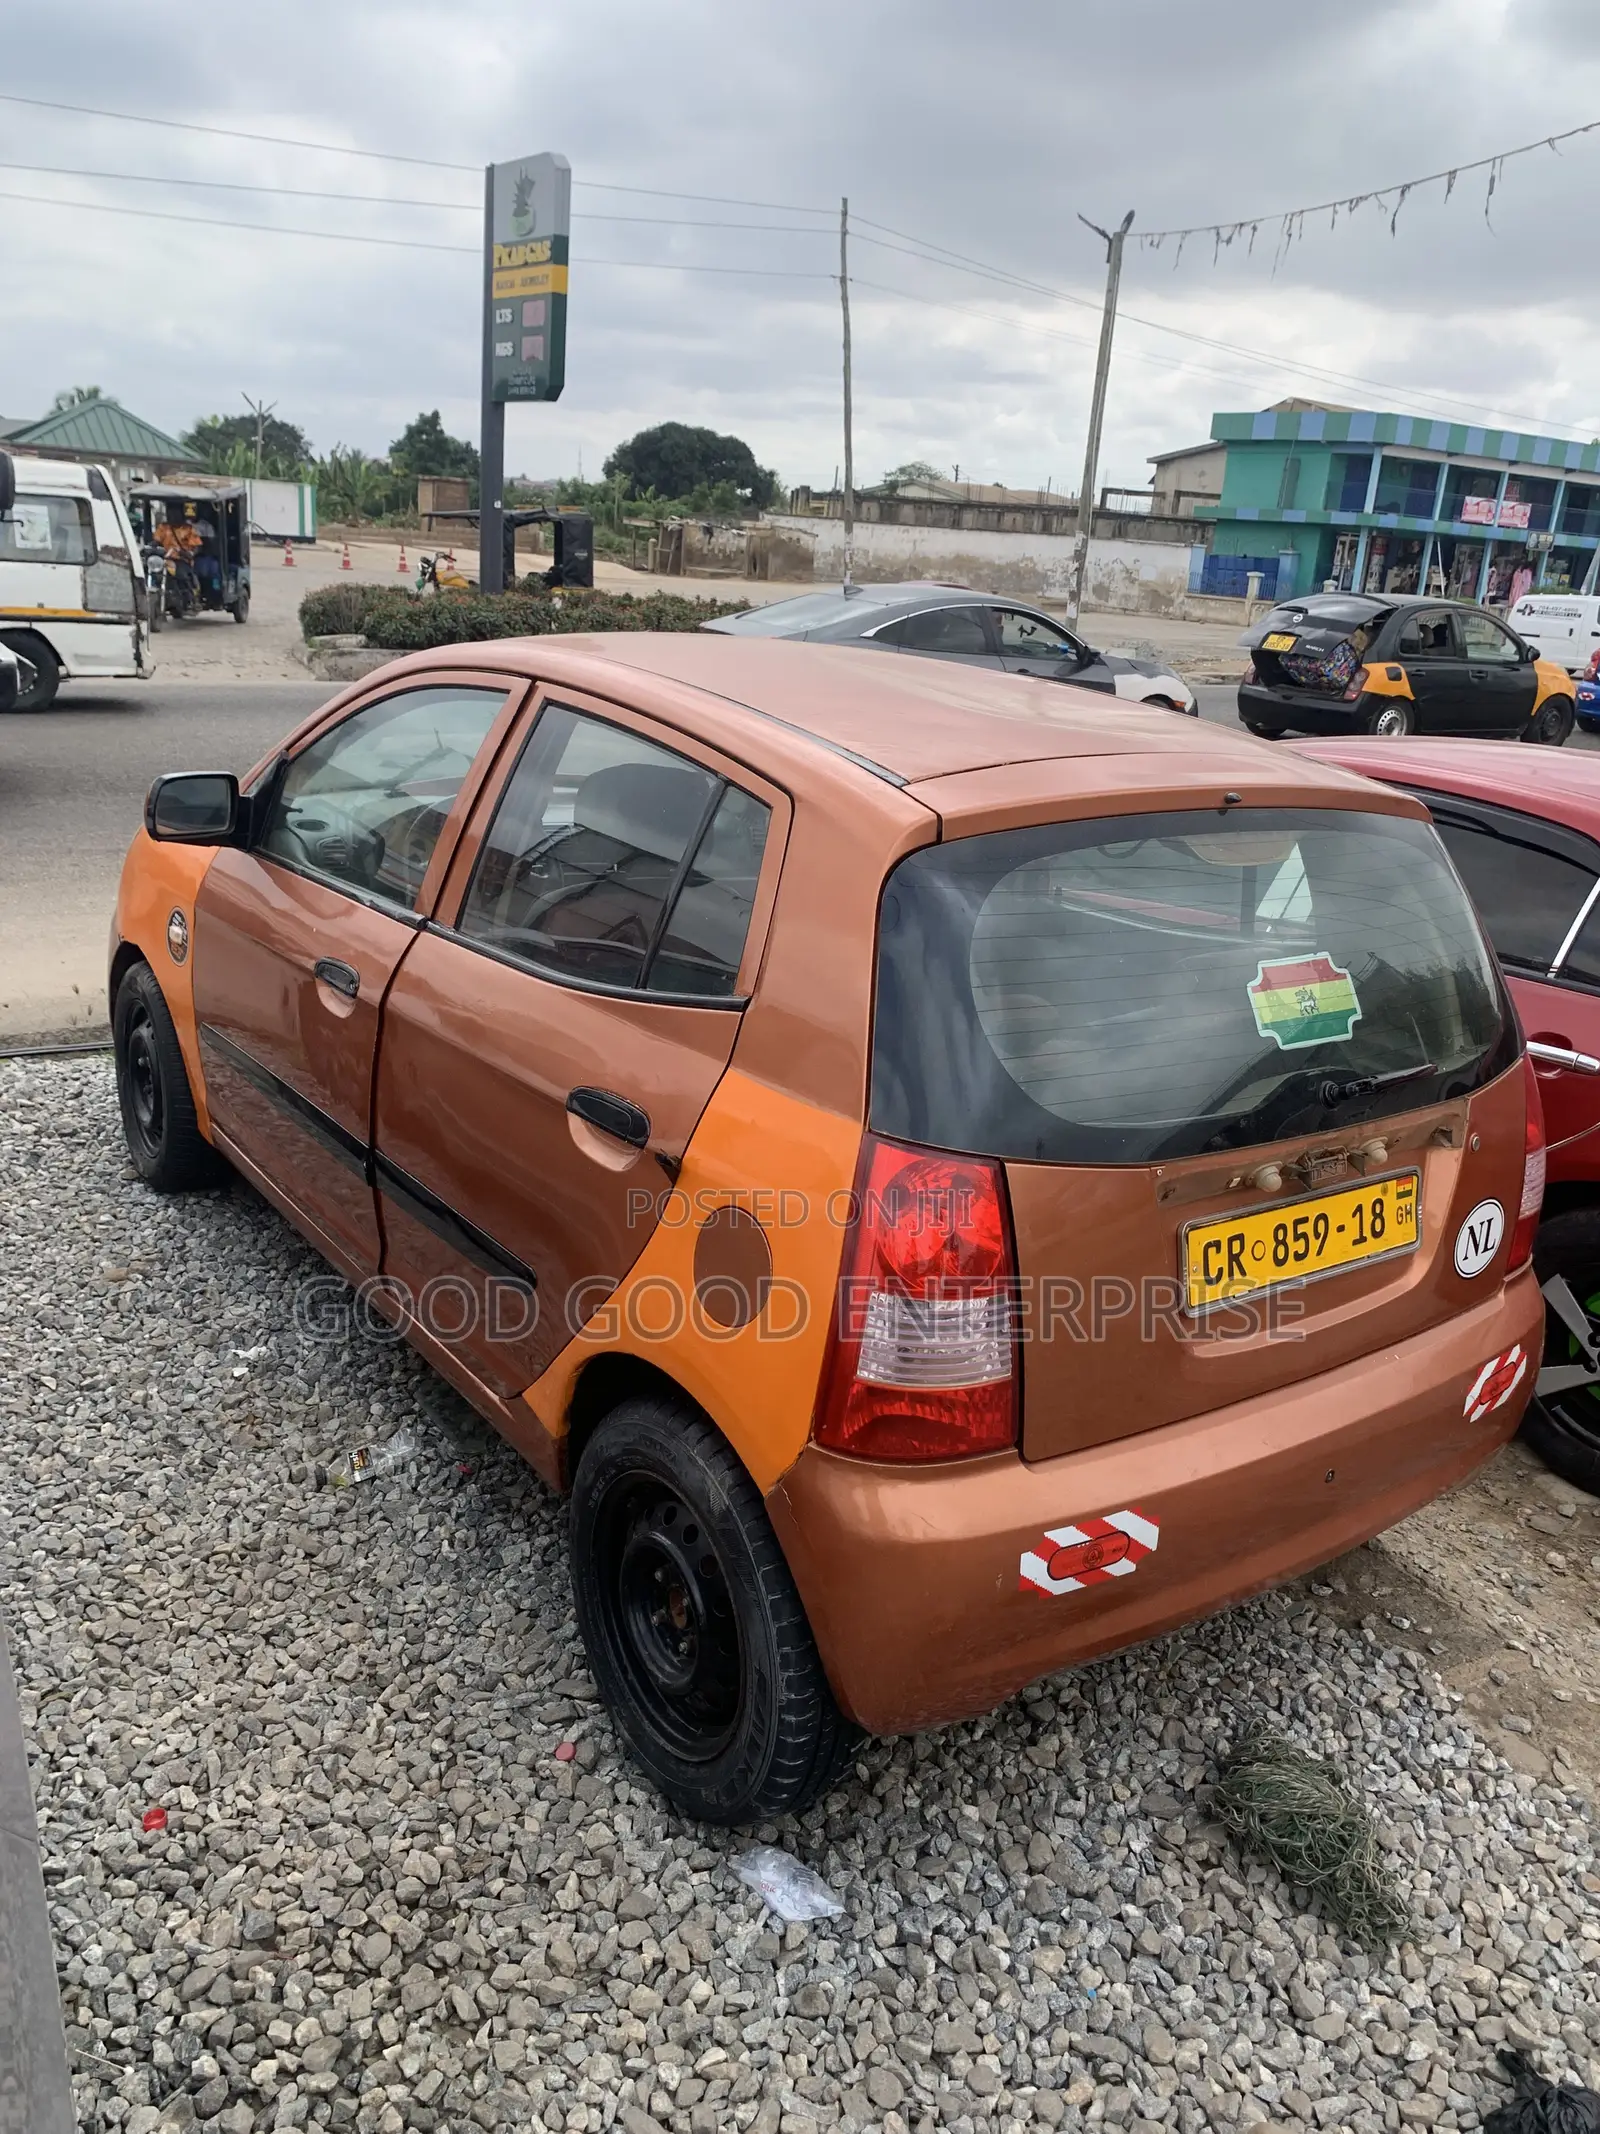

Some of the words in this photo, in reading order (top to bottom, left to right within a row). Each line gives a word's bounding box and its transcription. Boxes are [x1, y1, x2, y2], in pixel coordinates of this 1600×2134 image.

[1396, 1202, 1414, 1227] GH
[1203, 1232, 1248, 1287] CR
[1272, 1197, 1387, 1269] 859-18
[1461, 1217, 1498, 1262] NL
